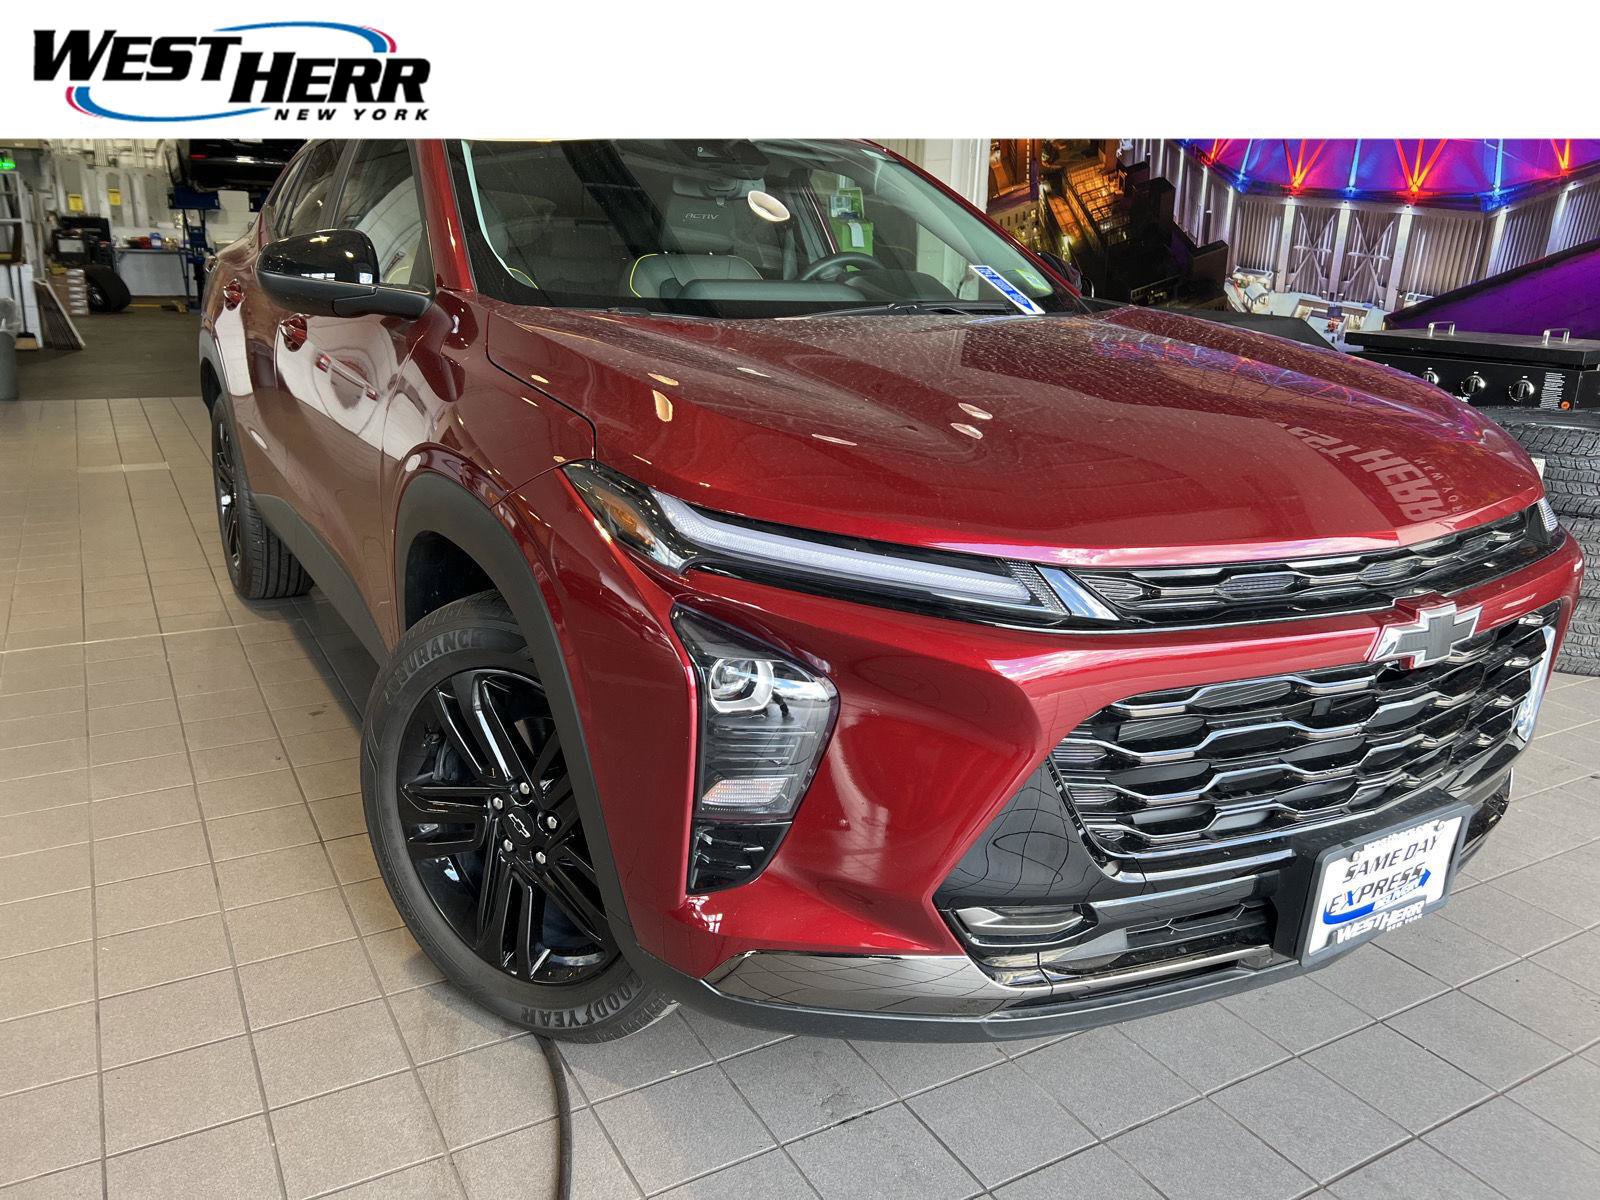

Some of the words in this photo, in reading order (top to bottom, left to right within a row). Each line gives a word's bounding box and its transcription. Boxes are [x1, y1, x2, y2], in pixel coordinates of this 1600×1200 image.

[1342, 848, 1402, 884] SAME
[1403, 835, 1439, 861] DAY
[1329, 862, 1426, 915] EXPRESS
[1337, 913, 1384, 943] WEST
[1378, 901, 1425, 930] HERR
